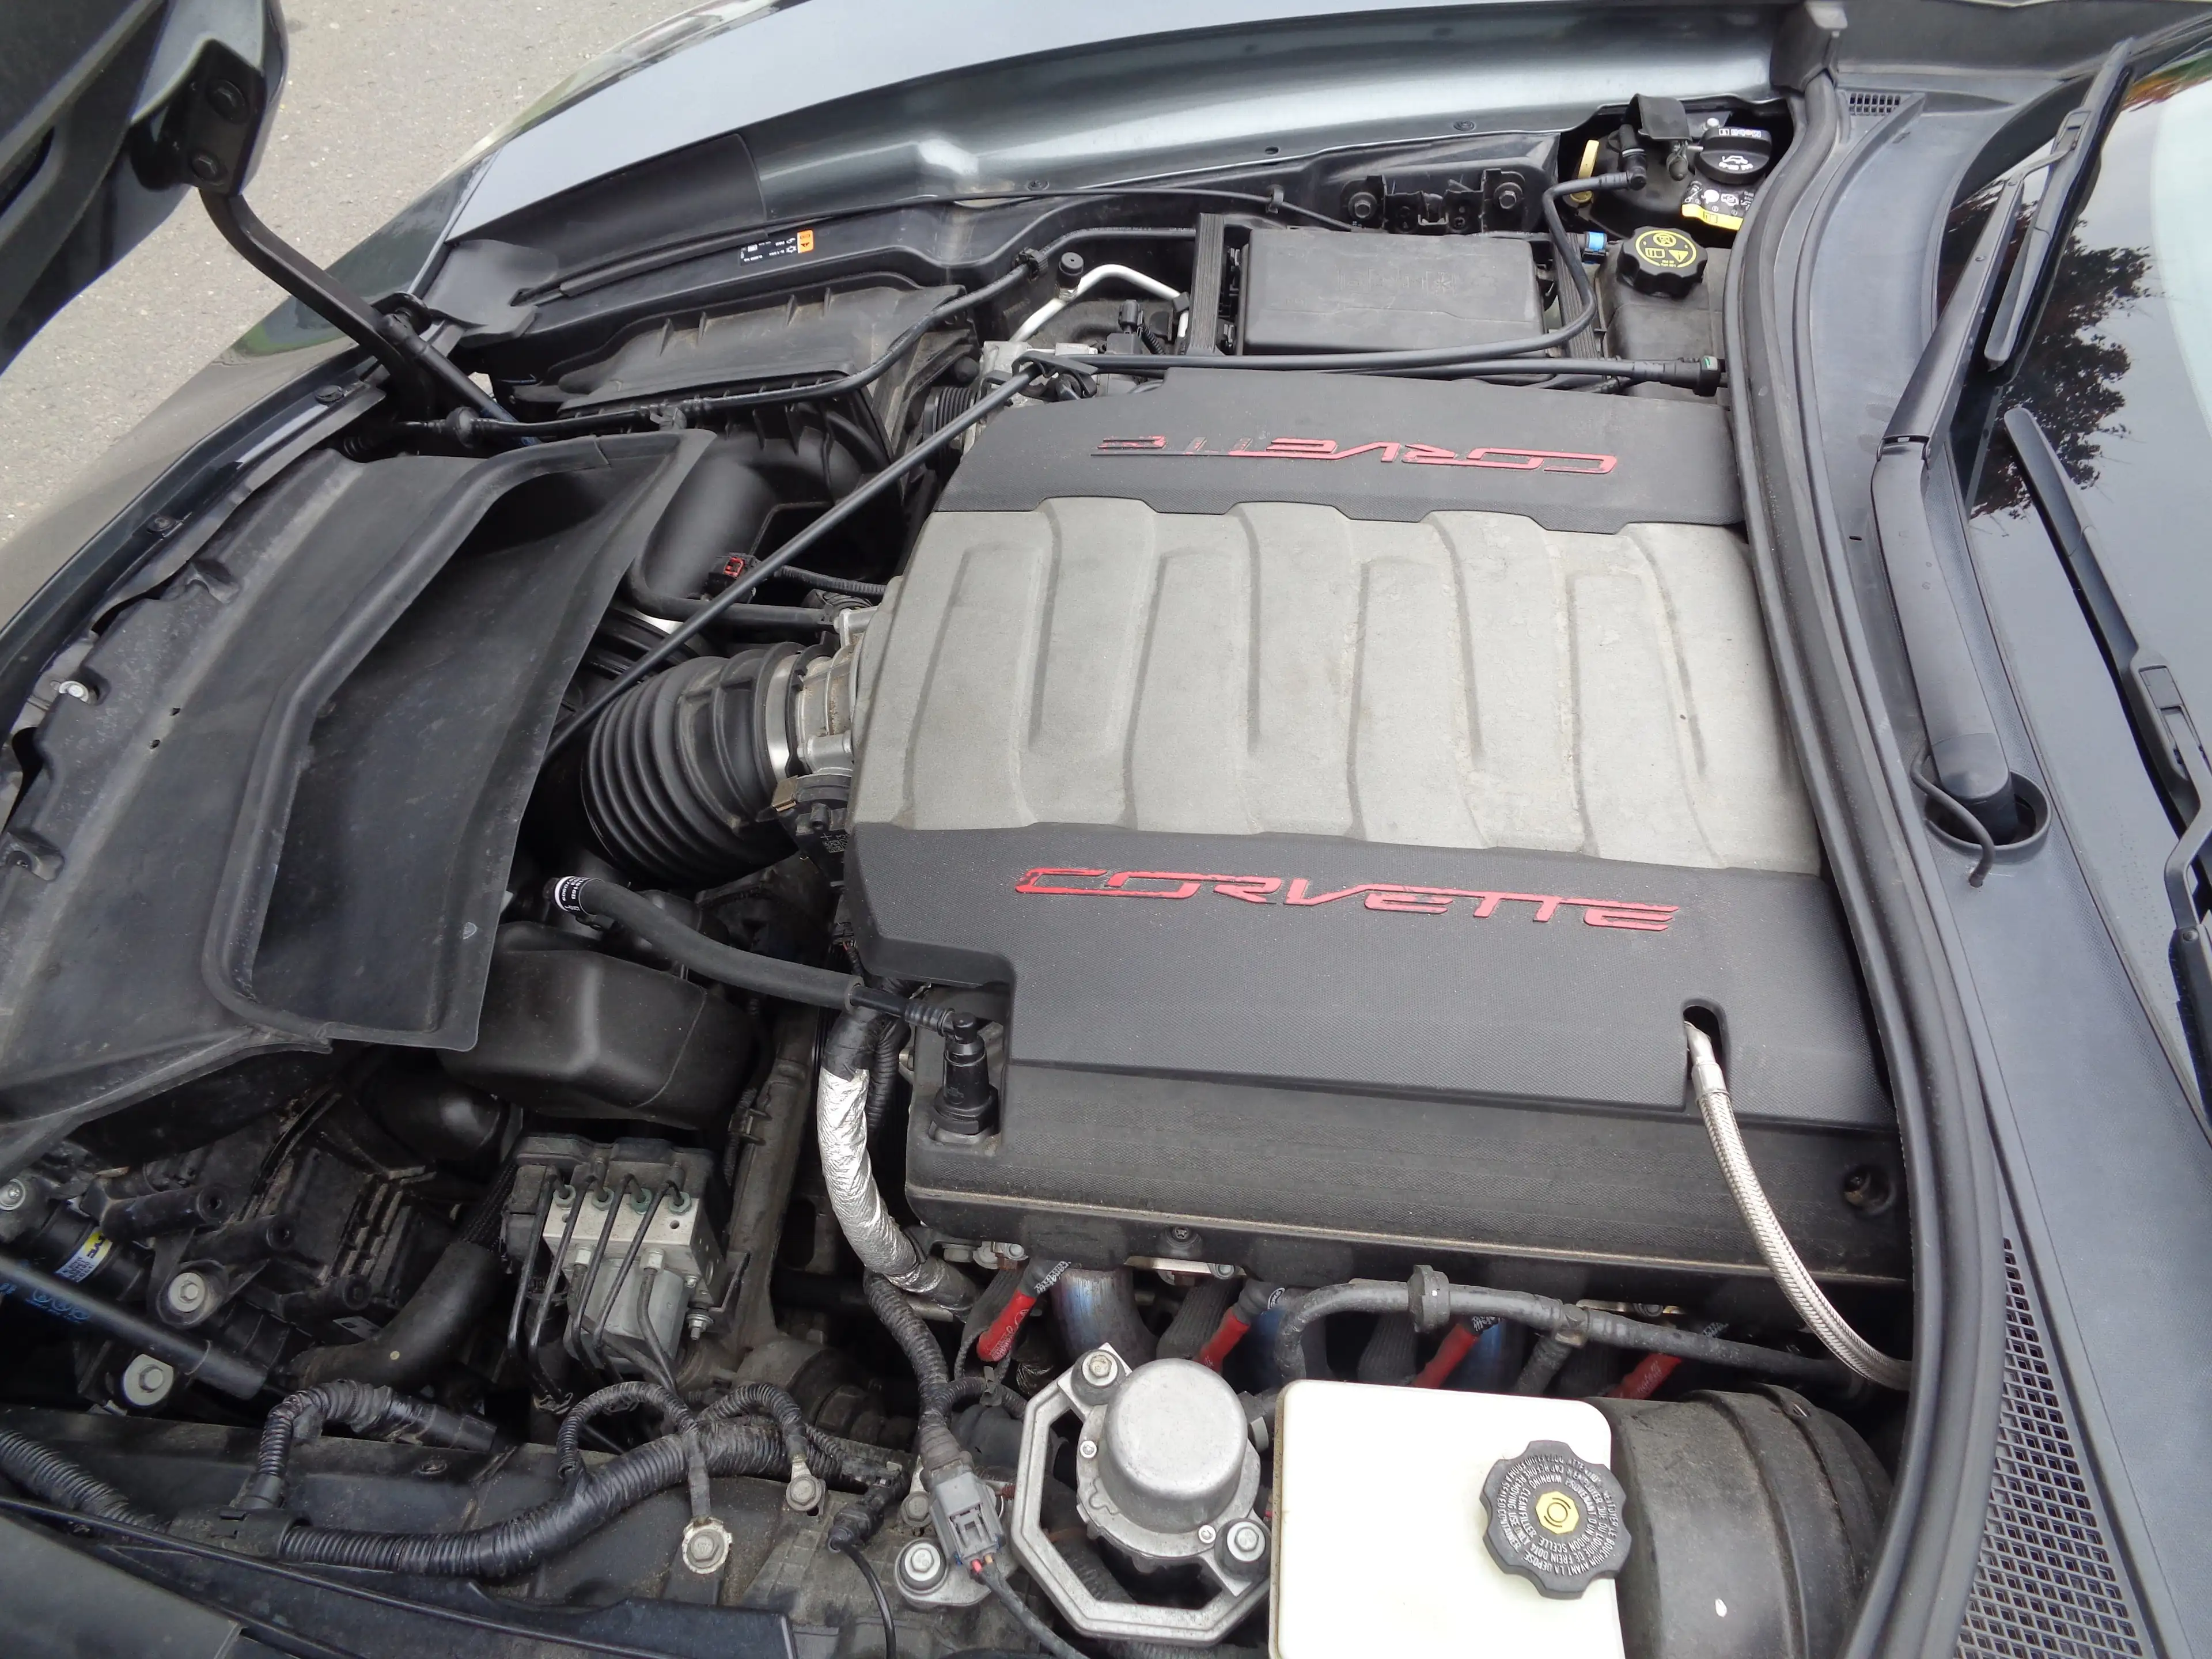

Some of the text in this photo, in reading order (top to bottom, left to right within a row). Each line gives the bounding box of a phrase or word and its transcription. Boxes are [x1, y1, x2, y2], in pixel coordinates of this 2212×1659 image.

[1091, 435, 1618, 475] CORVETTE
[1016, 867, 1679, 932] CORVETTE
[1523, 1452, 1544, 1467] FLUID
[1507, 1460, 1526, 1478] FROM
[1522, 1464, 1549, 1479] BEFORE
[1517, 1475, 1561, 1538] WARNING CLEAN FILLER
[1508, 1512, 1518, 1527] USE
[1514, 1526, 1531, 1546] ONLY
[1537, 1538, 1567, 1551] SCELLE
[1588, 1537, 1616, 1567] BOUCHON
[1549, 1552, 1573, 1563] FREIN
[1567, 1561, 1590, 1575] AVANT
